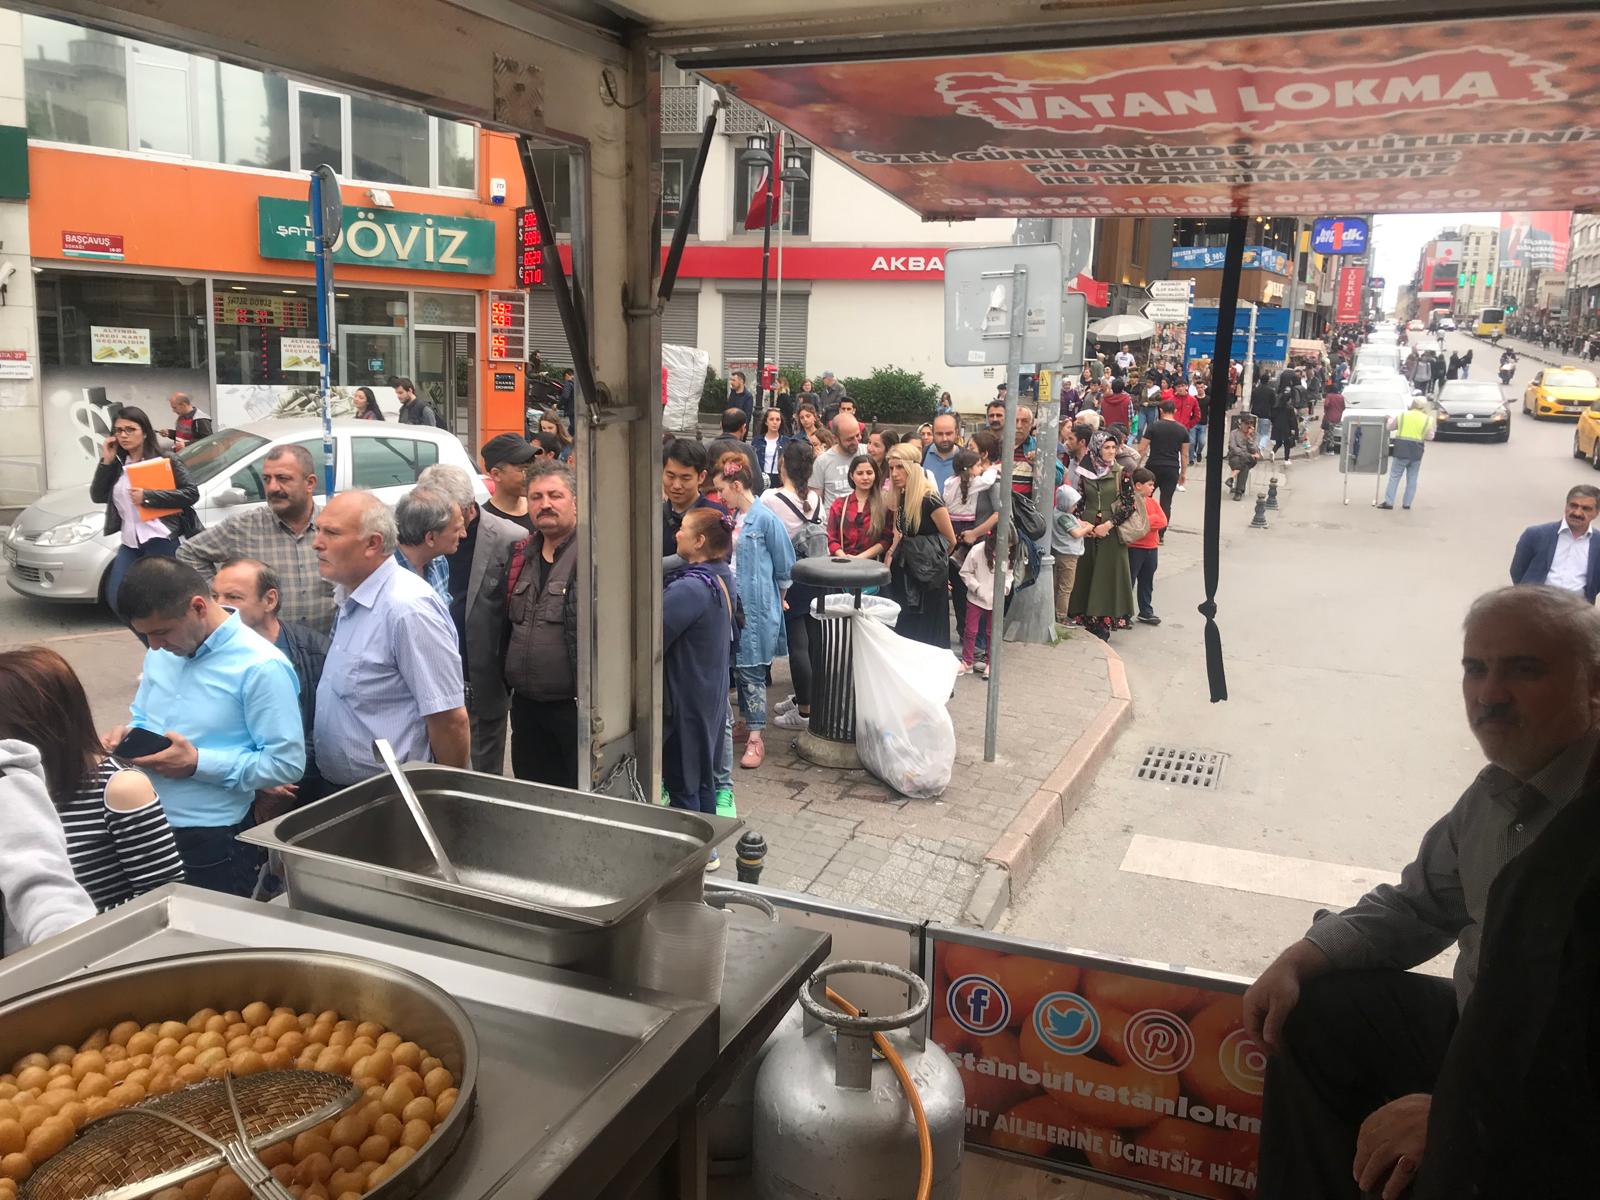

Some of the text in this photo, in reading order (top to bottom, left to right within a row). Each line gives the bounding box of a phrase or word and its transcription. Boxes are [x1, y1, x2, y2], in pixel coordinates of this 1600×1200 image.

[992, 71, 1499, 120] VATAN LOKMA
[852, 150, 953, 165] ÖZEL
[951, 144, 1251, 162] GÜNLERİNİZDE
[1022, 160, 1139, 174] PİLAV
[1036, 172, 1098, 185] İLE
[1124, 196, 1171, 205] 14
[65, 234, 110, 246] BAŞÇAVUŞ
[871, 255, 945, 272] AKBA
[965, 1103, 990, 1127] HİT
[993, 1112, 1103, 1153] AİLELERİNE
[1110, 1134, 1203, 1177] ÜCRETSİZ
